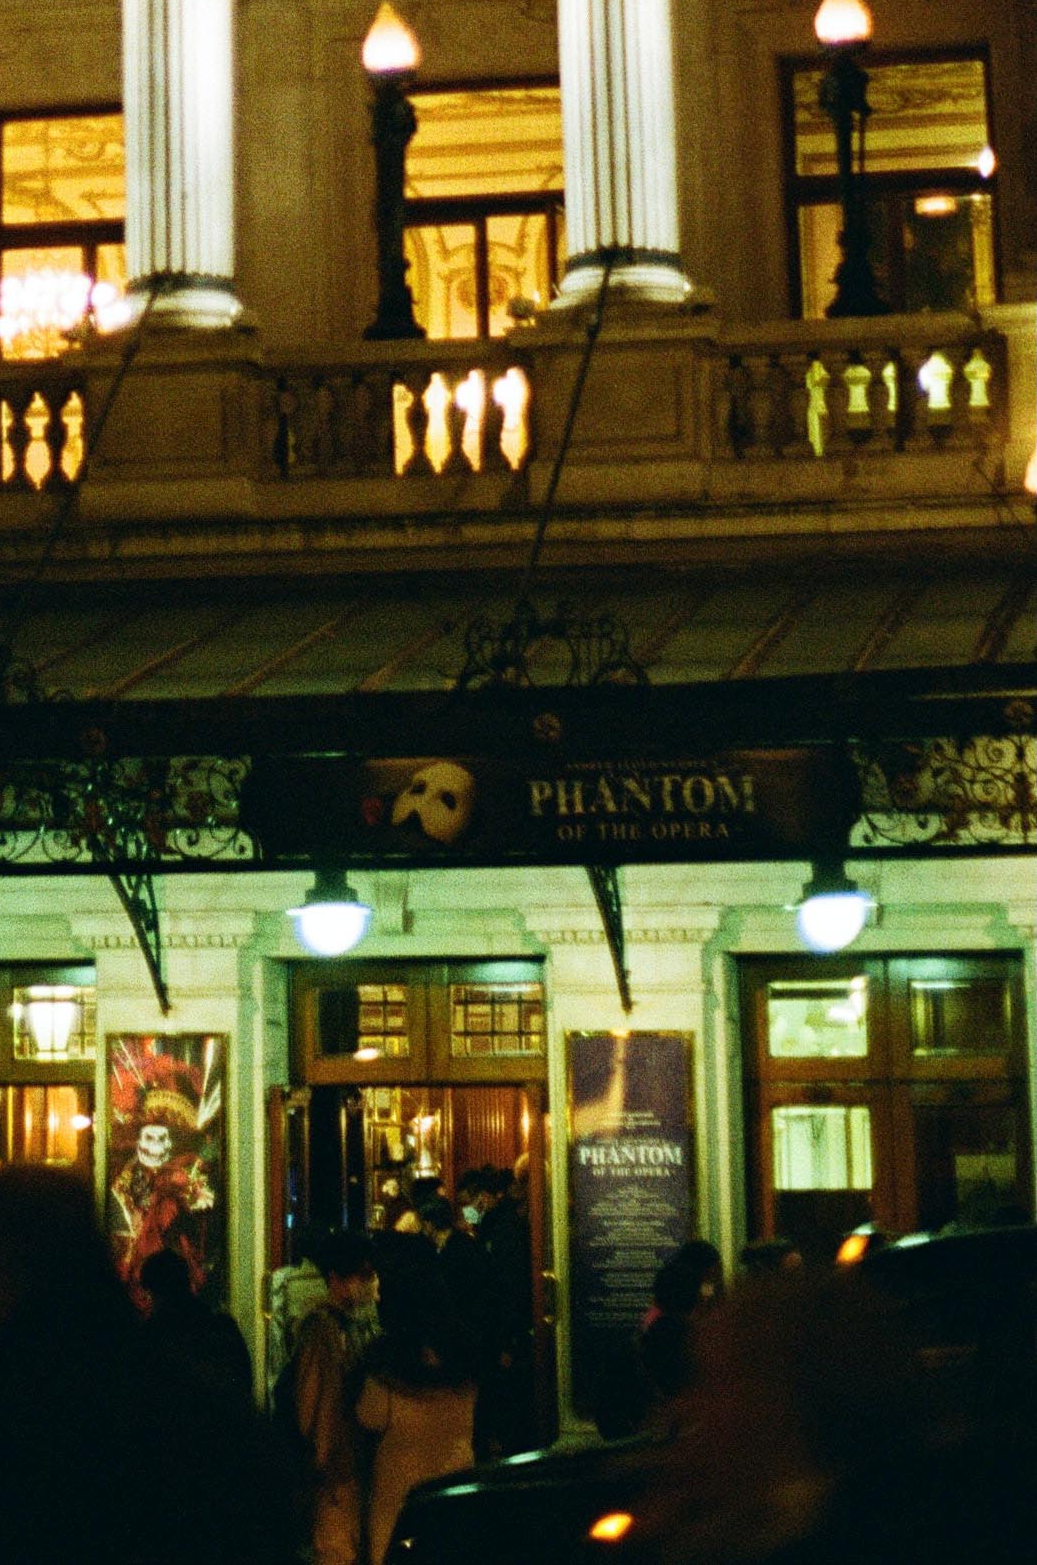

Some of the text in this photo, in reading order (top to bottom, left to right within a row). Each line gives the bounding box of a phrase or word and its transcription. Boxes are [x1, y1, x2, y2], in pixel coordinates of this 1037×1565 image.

[527, 773, 755, 816] PHANTOM
[557, 821, 730, 841] OF THE OPERA
[578, 1143, 683, 1166] PHANTOM
[592, 1167, 671, 1177] OF THE OPERA
